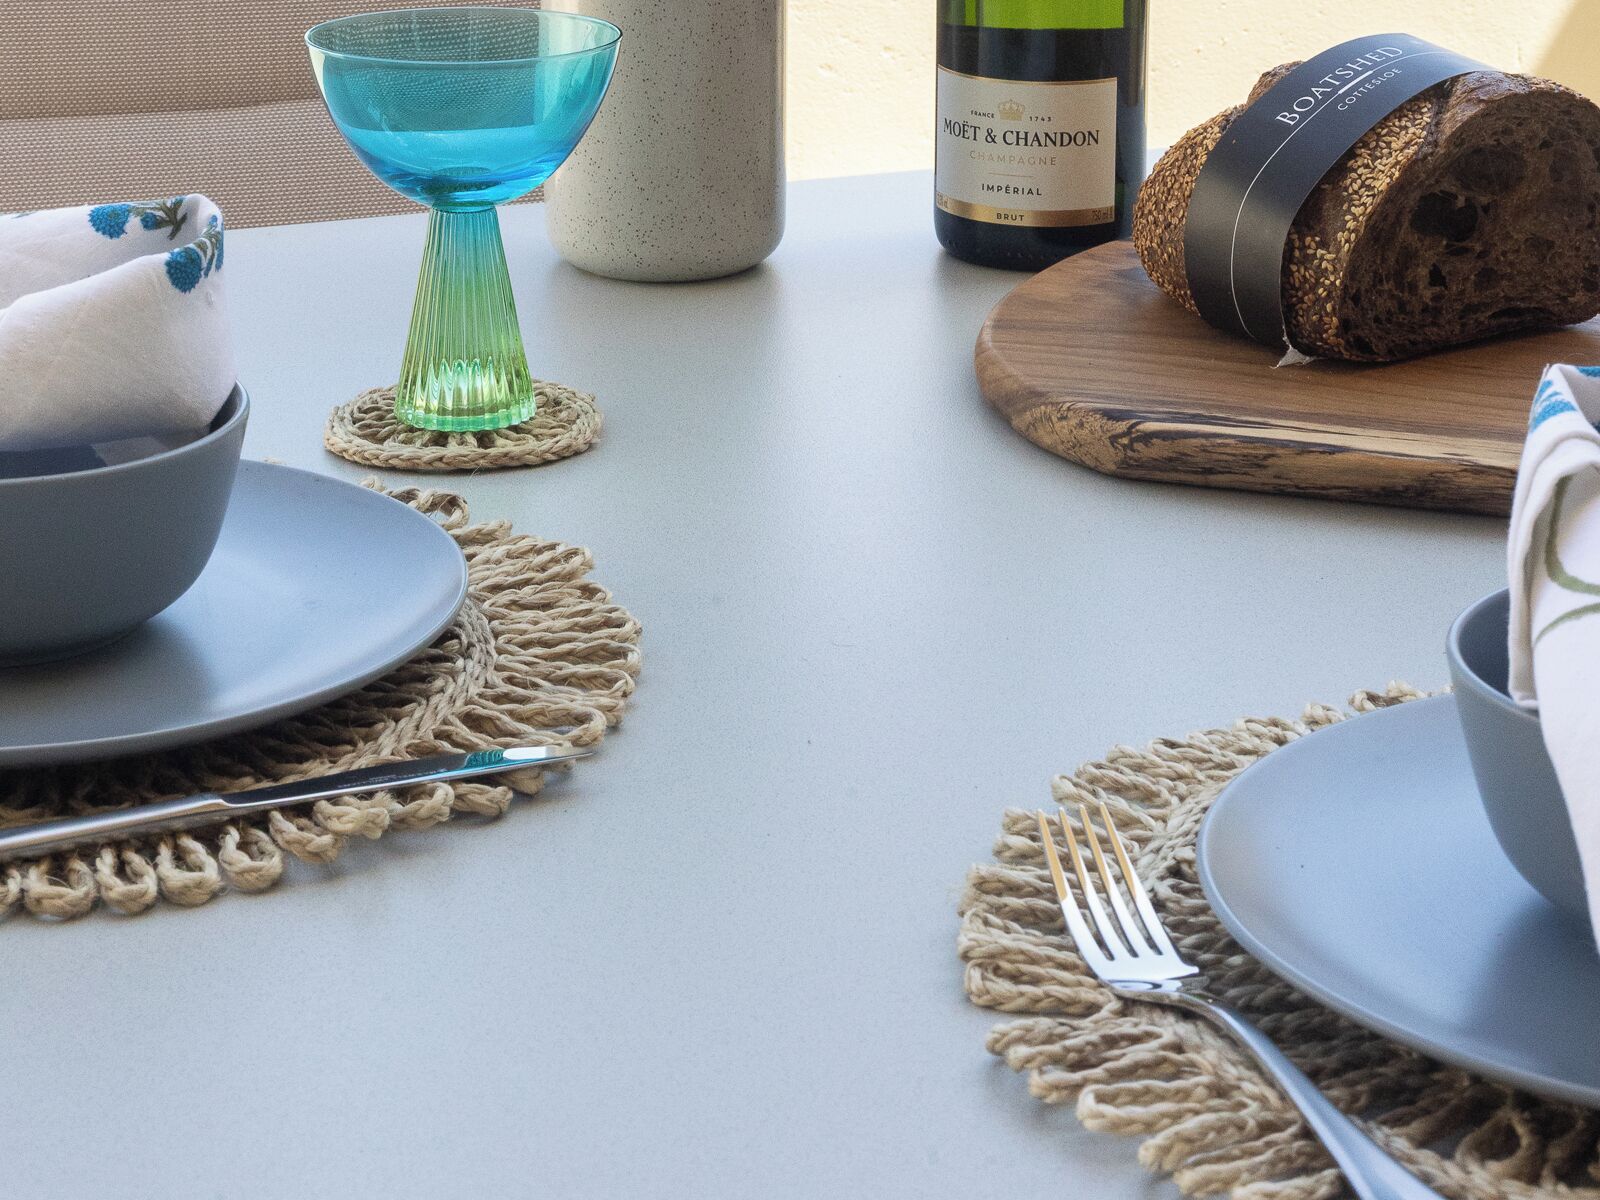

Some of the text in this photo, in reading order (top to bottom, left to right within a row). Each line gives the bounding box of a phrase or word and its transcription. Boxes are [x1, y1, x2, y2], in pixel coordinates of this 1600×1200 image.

[1274, 46, 1403, 126] BOATSHED
[1337, 67, 1402, 111] COTTESLOE
[970, 110, 995, 119] FRANCE
[943, 117, 1100, 148] MOËT & CHANDON
[969, 150, 1057, 166] CHAMPAGNE
[981, 183, 1042, 197] IMPÉRIAL
[996, 212, 1025, 222] BRUT
